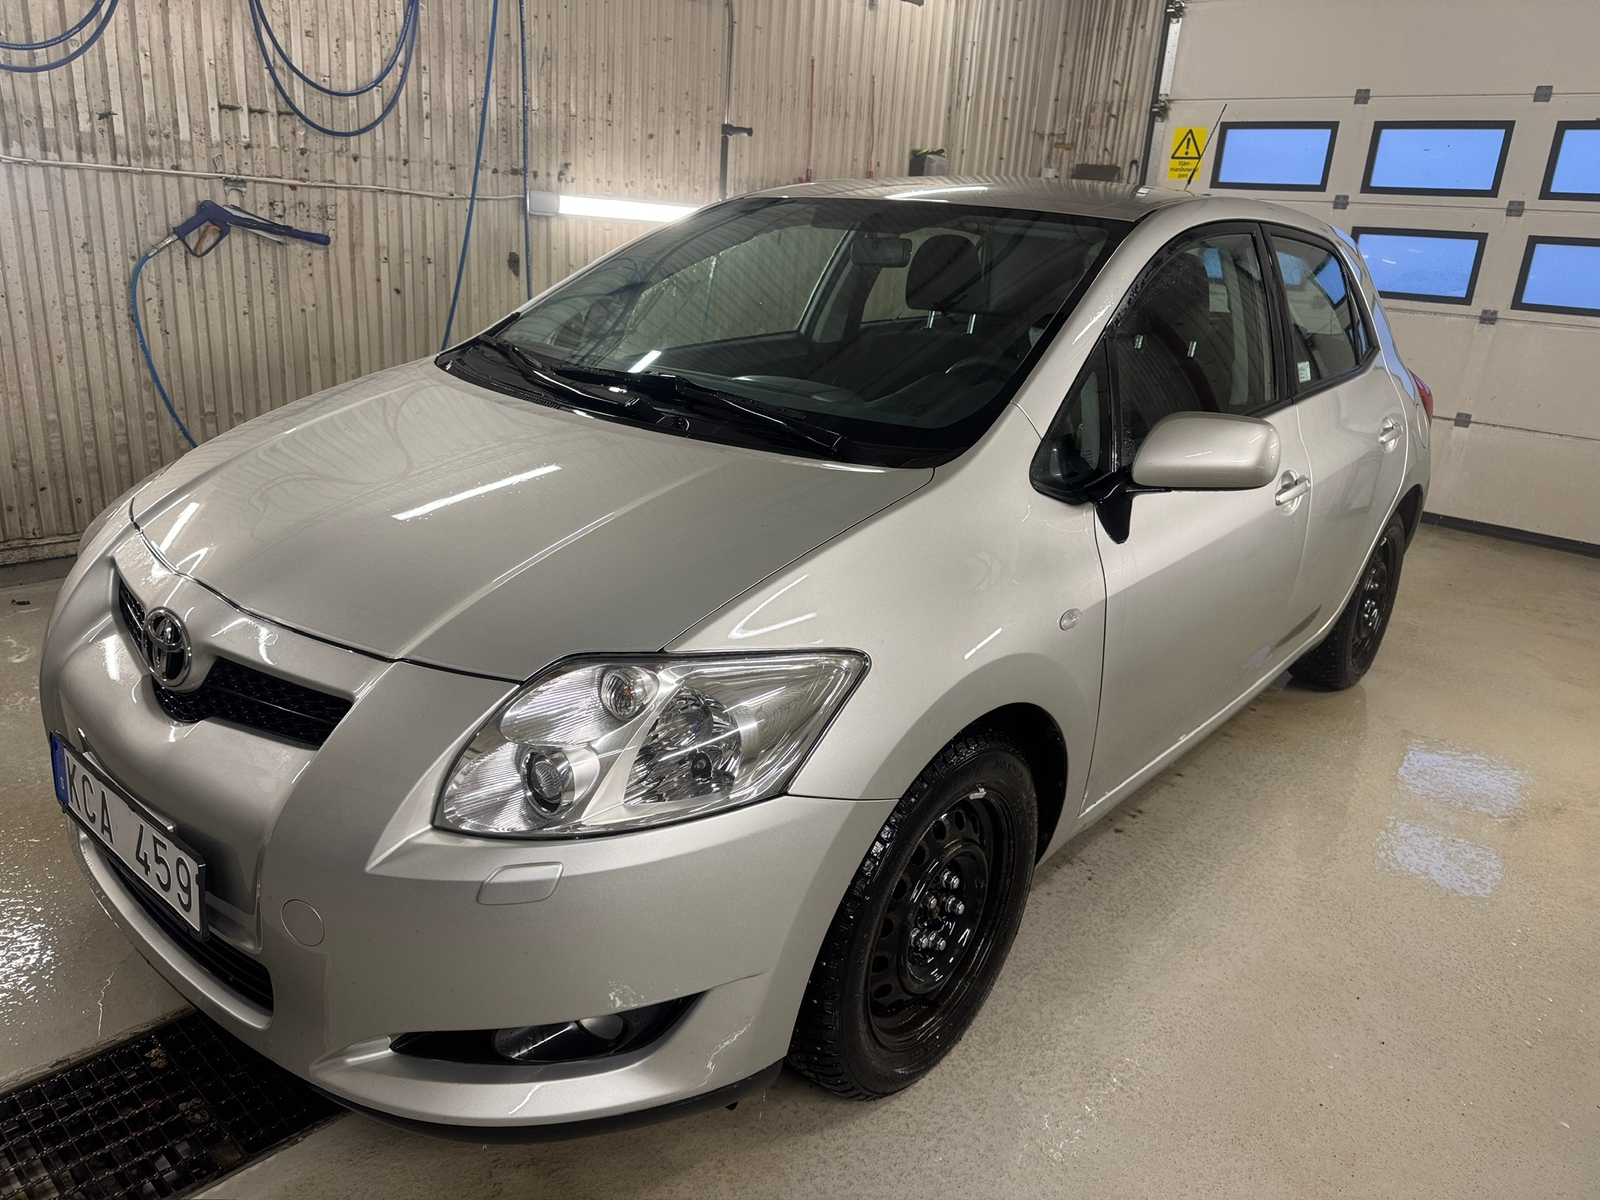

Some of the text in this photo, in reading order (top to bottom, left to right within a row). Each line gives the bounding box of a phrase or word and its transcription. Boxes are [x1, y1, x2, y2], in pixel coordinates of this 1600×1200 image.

[60, 776, 65, 790] S
[66, 755, 193, 913] KCA 459
